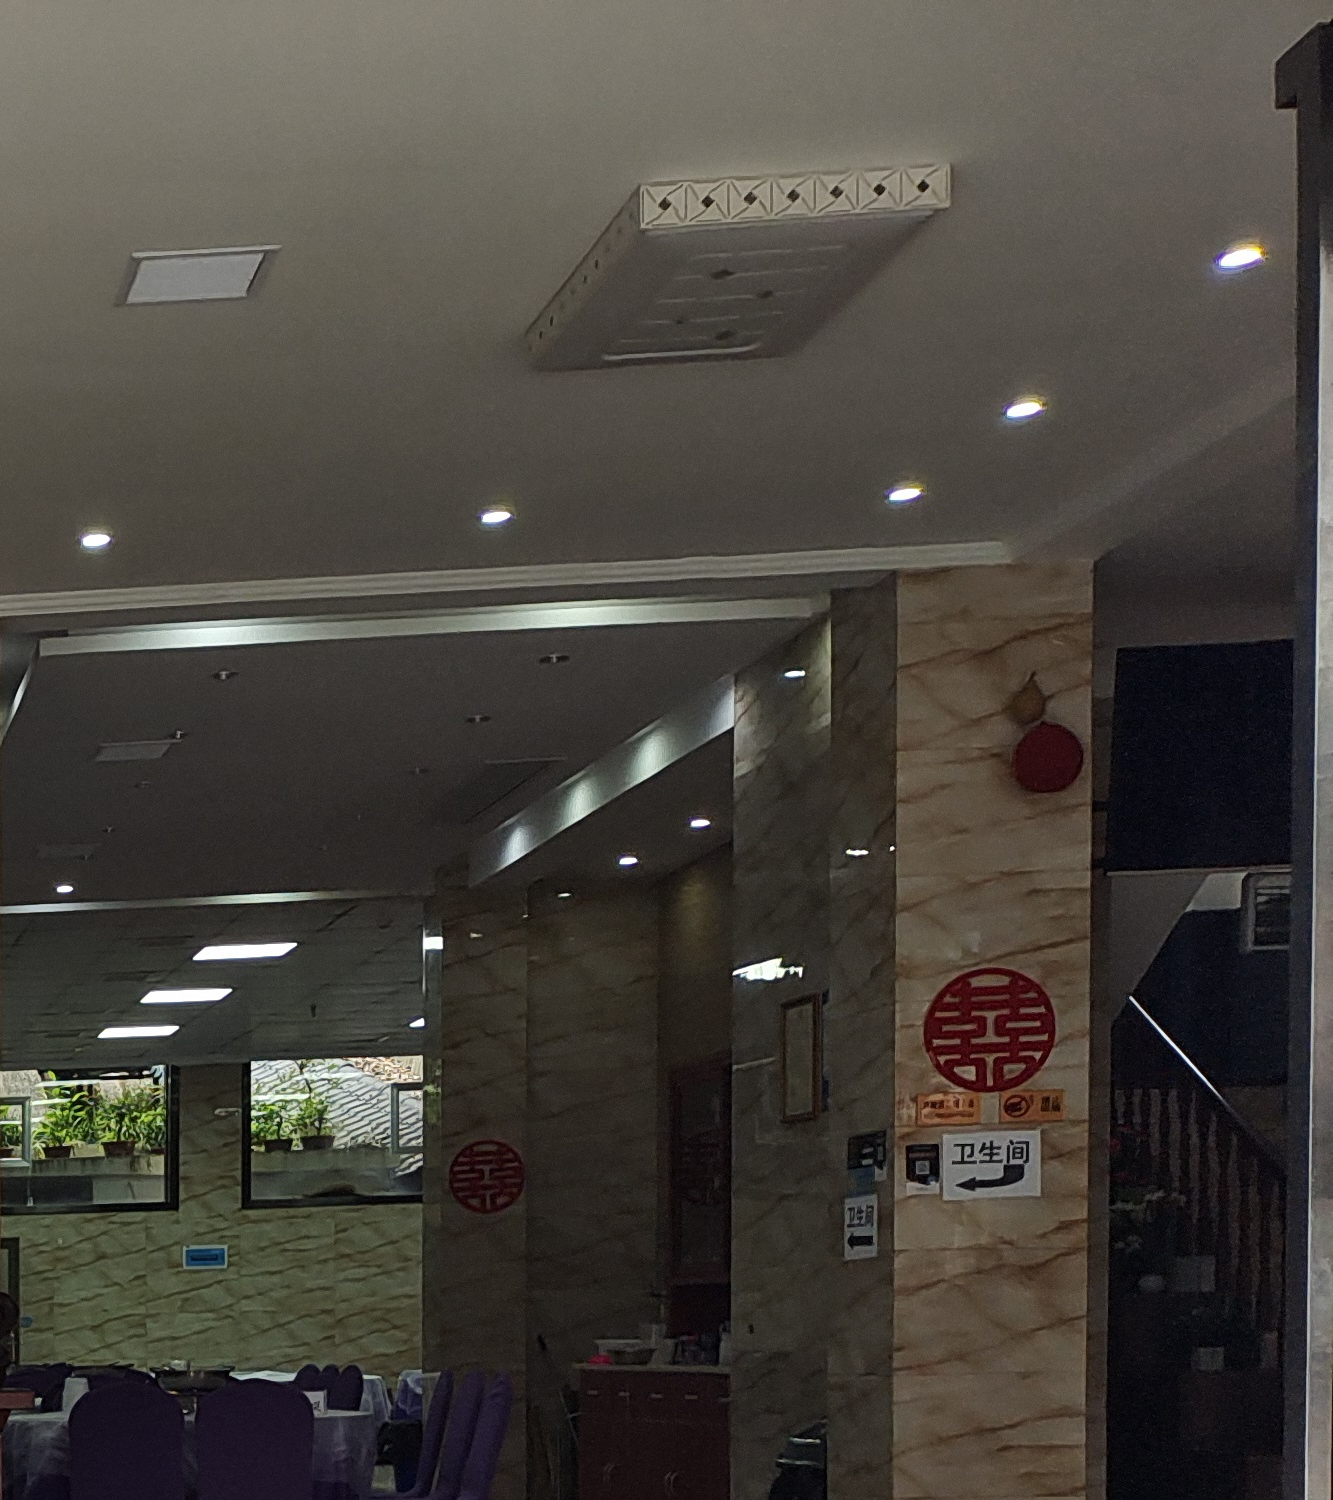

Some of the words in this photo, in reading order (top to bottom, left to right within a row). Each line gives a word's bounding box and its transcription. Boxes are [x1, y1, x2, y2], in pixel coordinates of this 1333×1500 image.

[952, 1140, 1029, 1165] 卫生间
[847, 1204, 874, 1228] 卫生间
